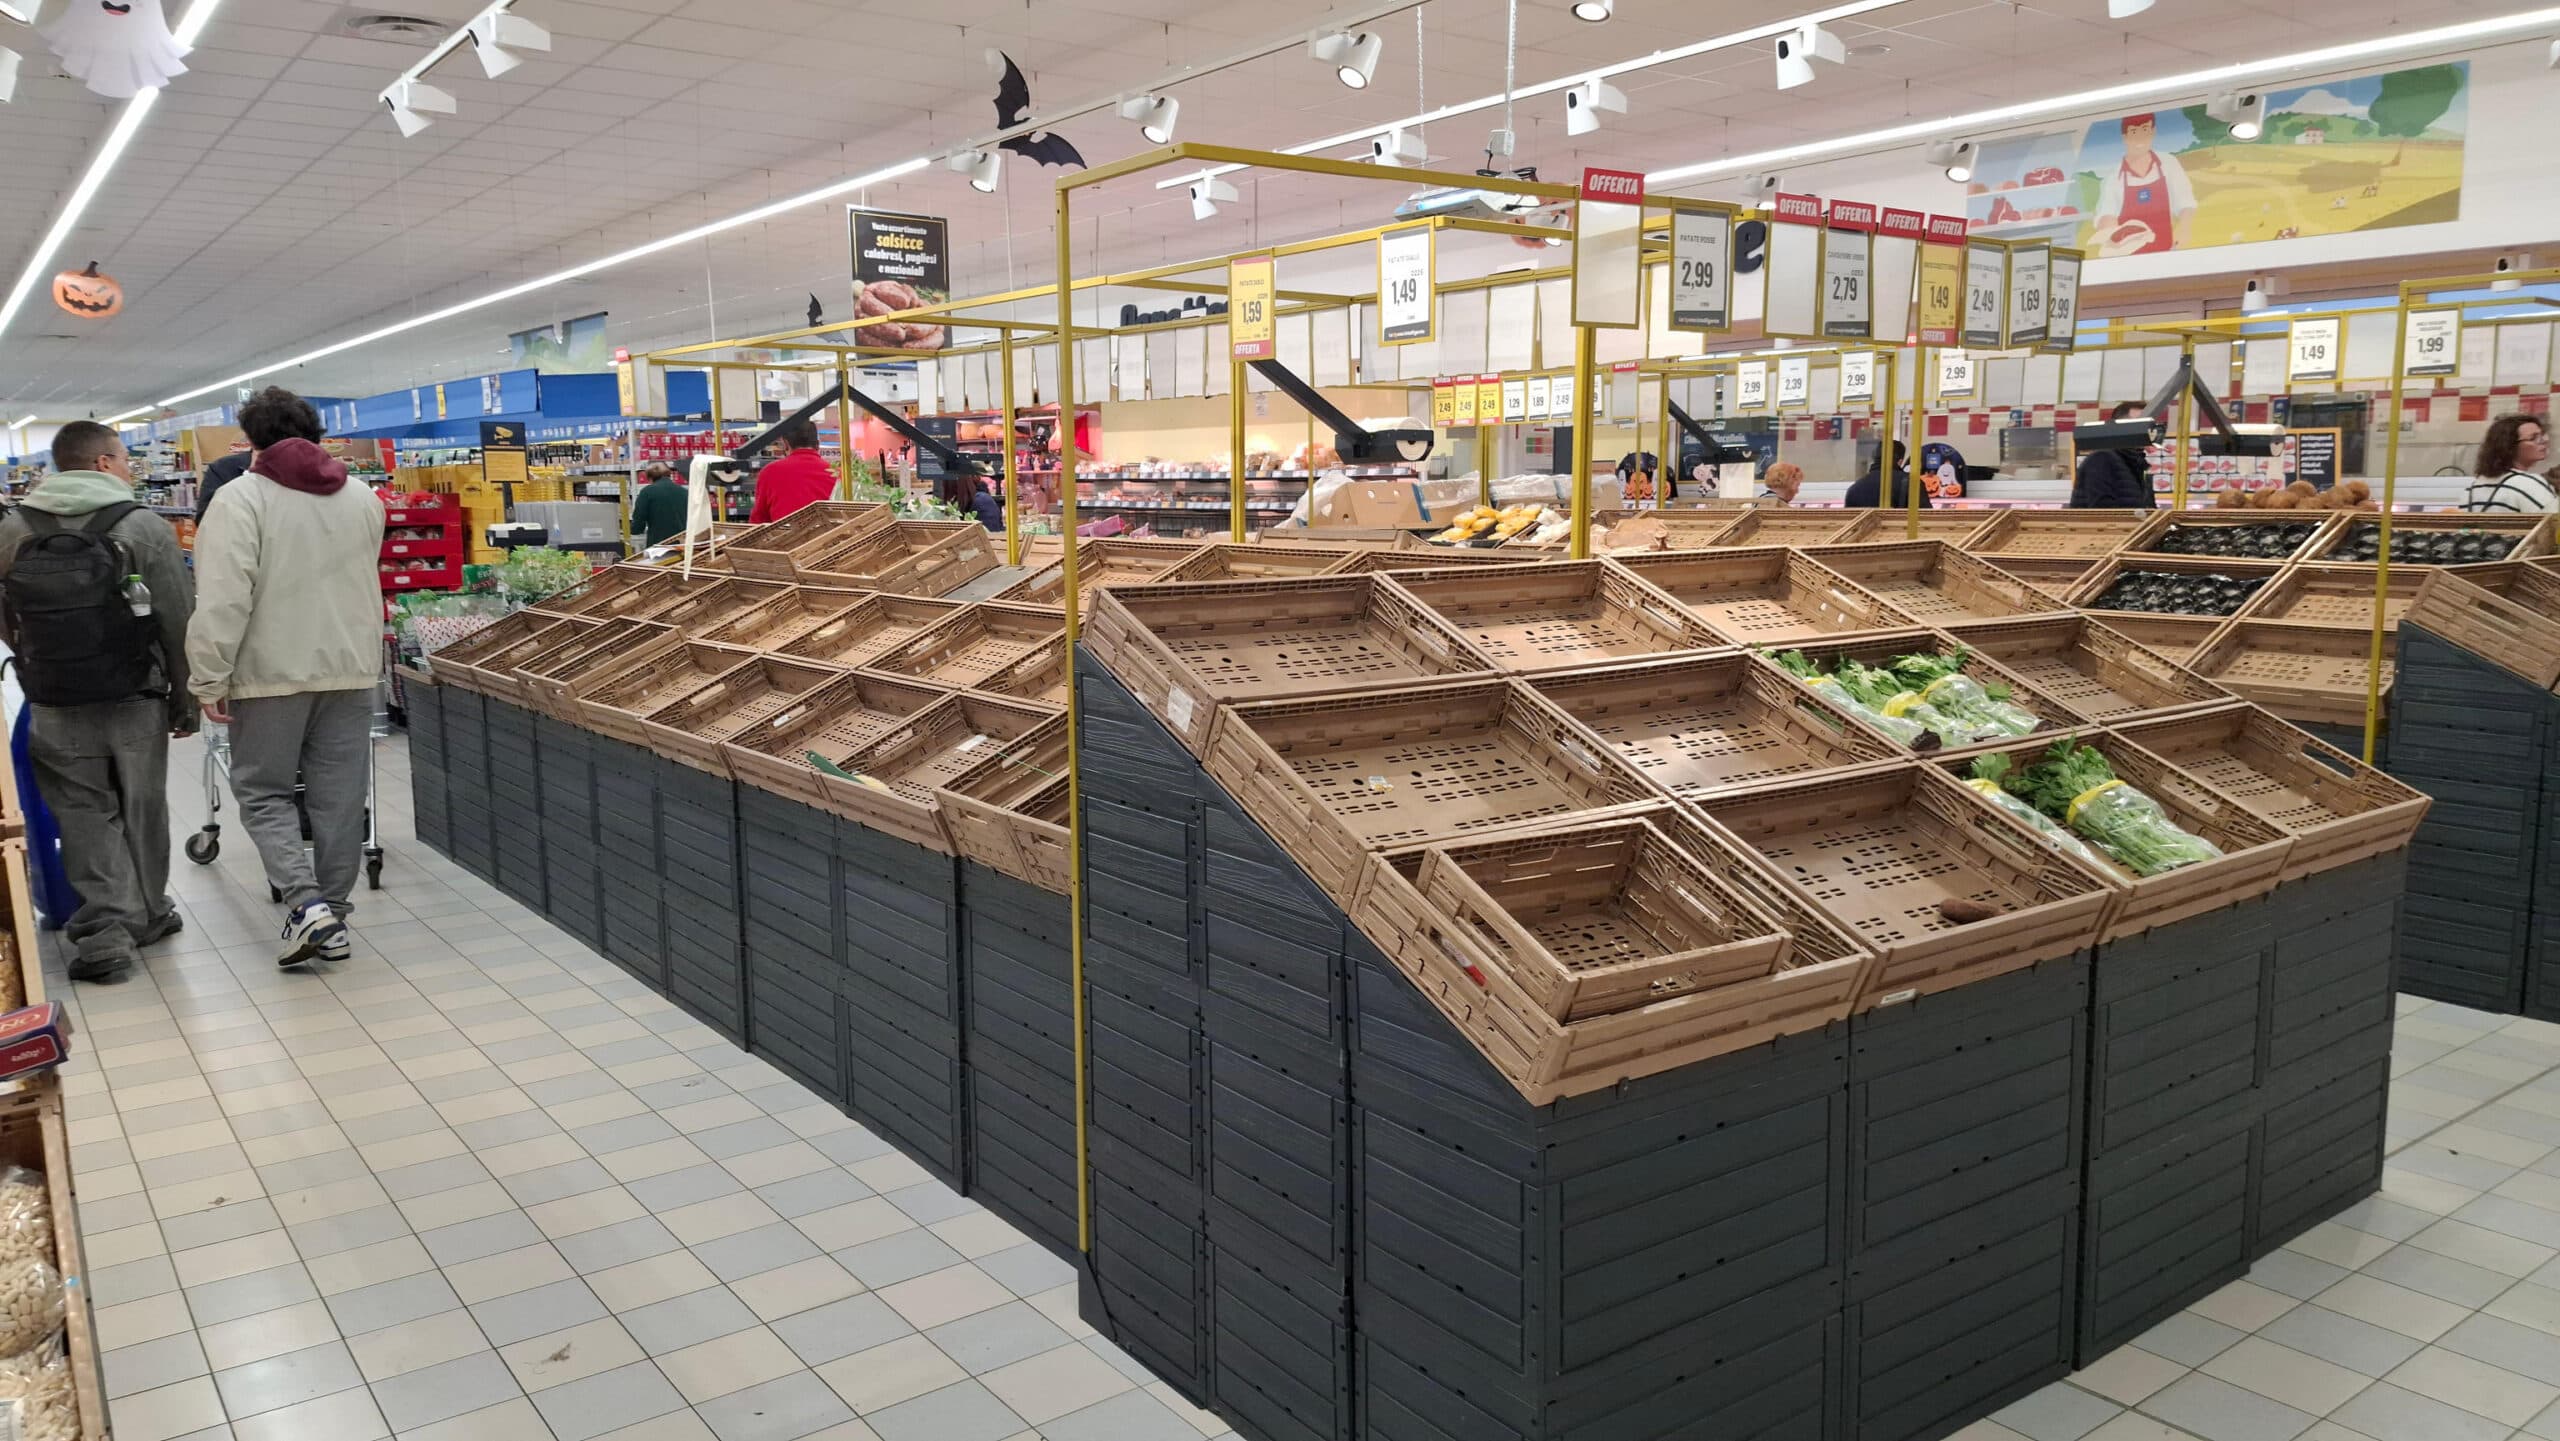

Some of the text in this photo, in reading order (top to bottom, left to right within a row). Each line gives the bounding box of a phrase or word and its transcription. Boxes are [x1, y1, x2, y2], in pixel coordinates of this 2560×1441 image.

[1589, 174, 1639, 195] OFFERTA
[1780, 198, 1818, 217] OFFERTA
[1834, 205, 1872, 224] OFFERTA
[1885, 213, 1921, 231] OFFERTA
[1931, 219, 1963, 236] OFFERTA
[876, 233, 924, 250] salsicce
[1681, 261, 1713, 290] 2,99
[1392, 278, 1417, 306] 1,49
[1832, 276, 1857, 302] 2,79
[1930, 286, 1949, 309] 1,49
[1972, 289, 1994, 312] 2,49
[2020, 289, 2040, 312] 1,69
[2050, 298, 2070, 319] 2,99
[1242, 301, 1262, 325] 1,59
[1235, 343, 1260, 355] OFFERTA
[2300, 345, 2326, 360] 1,49
[2417, 337, 2445, 353] 1,99
[1847, 374, 1866, 386] 2,99
[1945, 367, 1966, 380] 2,99
